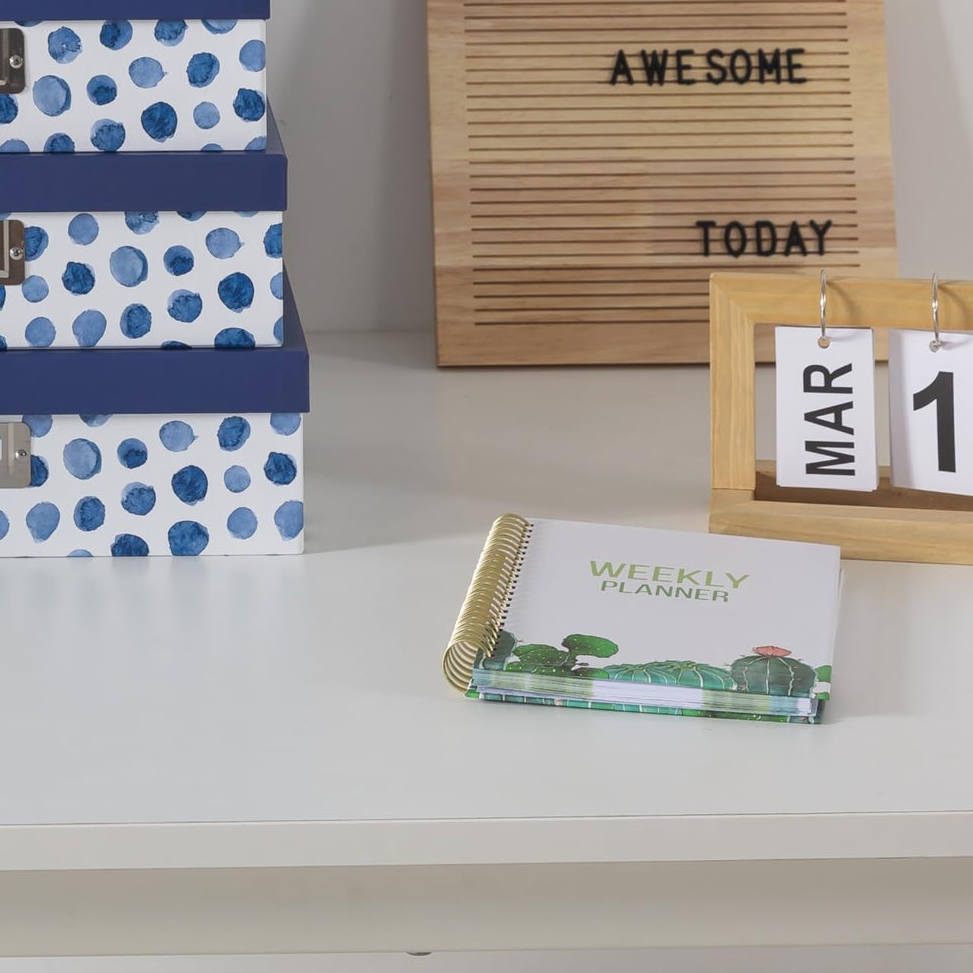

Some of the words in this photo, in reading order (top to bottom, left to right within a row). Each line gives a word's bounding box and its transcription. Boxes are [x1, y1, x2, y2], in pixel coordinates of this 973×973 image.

[610, 47, 808, 85] AWESOME
[696, 220, 833, 257] TODAY
[803, 362, 856, 476] MAR
[913, 371, 957, 473] 1
[589, 560, 750, 591] WEEKLY
[601, 579, 729, 603] PLANNER
